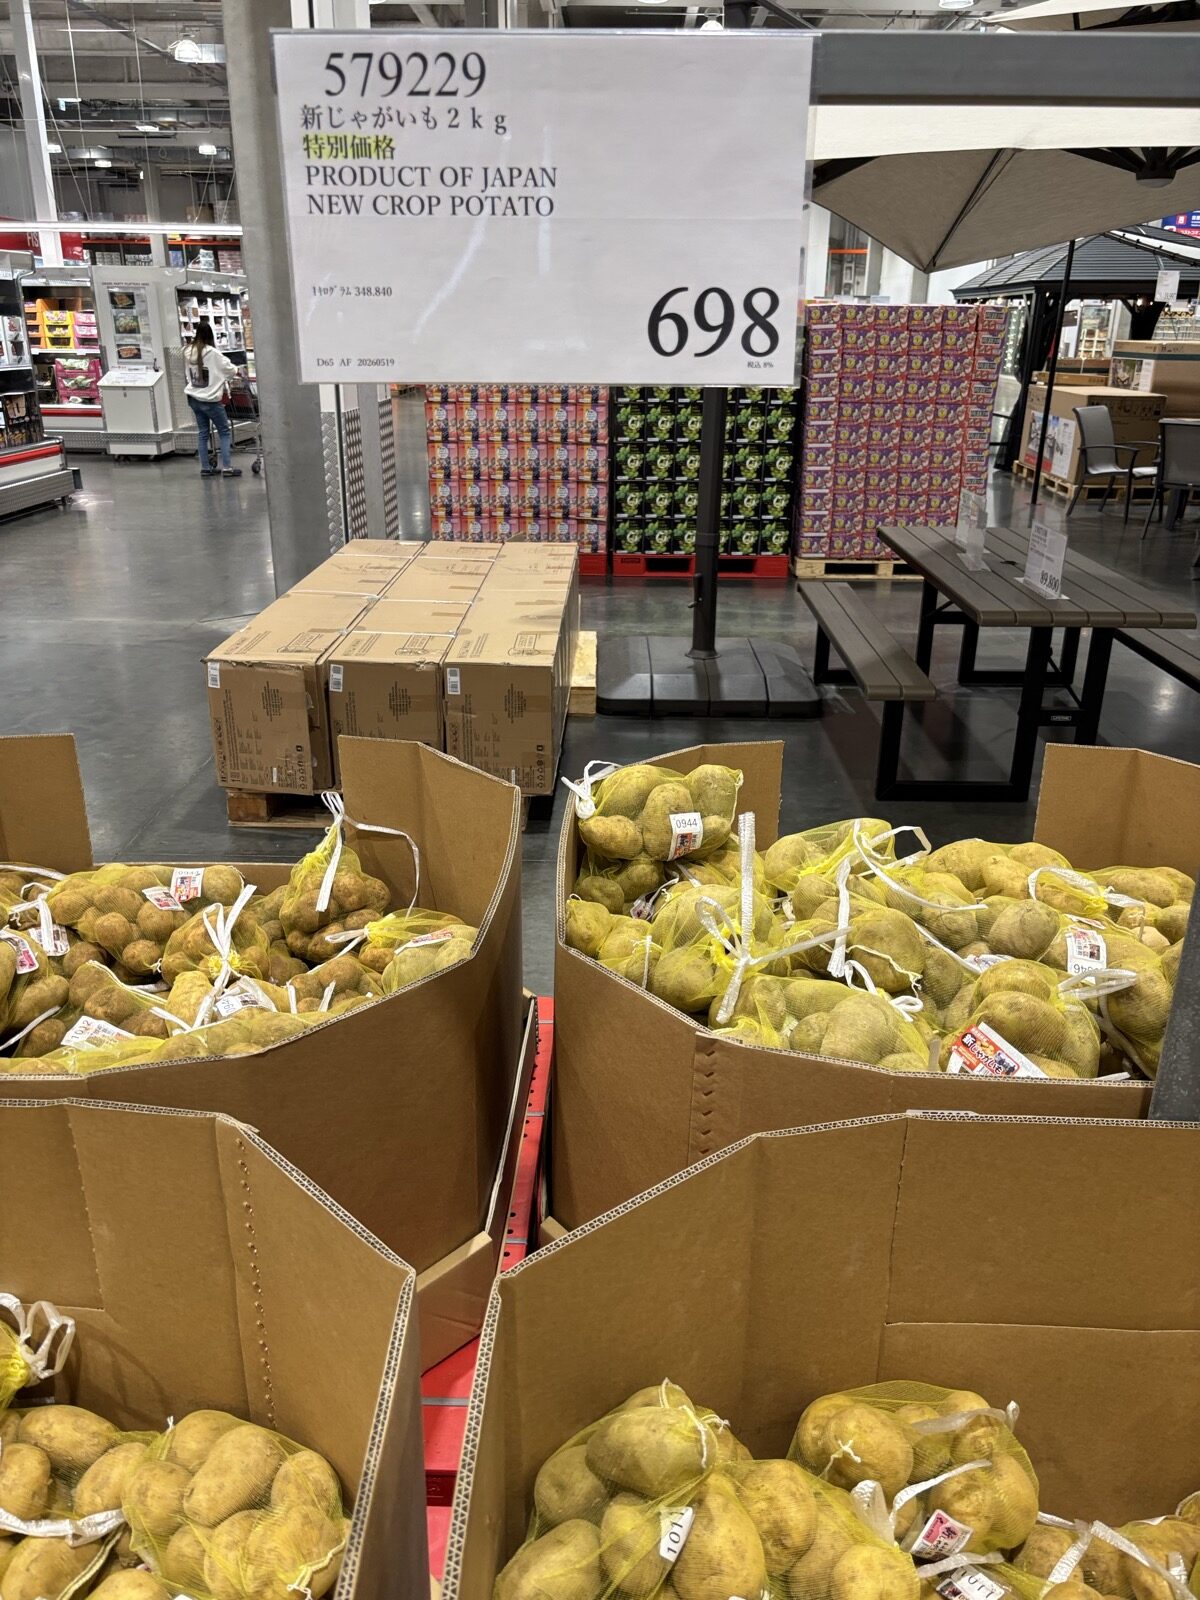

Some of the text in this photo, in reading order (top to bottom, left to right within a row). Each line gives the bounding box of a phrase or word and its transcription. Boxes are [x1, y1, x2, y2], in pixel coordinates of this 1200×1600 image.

[324, 51, 486, 98] 579229
[302, 133, 397, 161] 特別価格
[304, 165, 558, 193] PRODUCT OF JAPAN
[306, 193, 555, 217] NEW CROP POTATO
[354, 285, 393, 297] 348.840
[647, 286, 780, 358] 698
[316, 358, 334, 367] D65
[357, 358, 395, 367] 20260519
[675, 818, 698, 829] 0944
[961, 1033, 1003, 1075] 新じゃがいも
[667, 1511, 685, 1554] 1011
